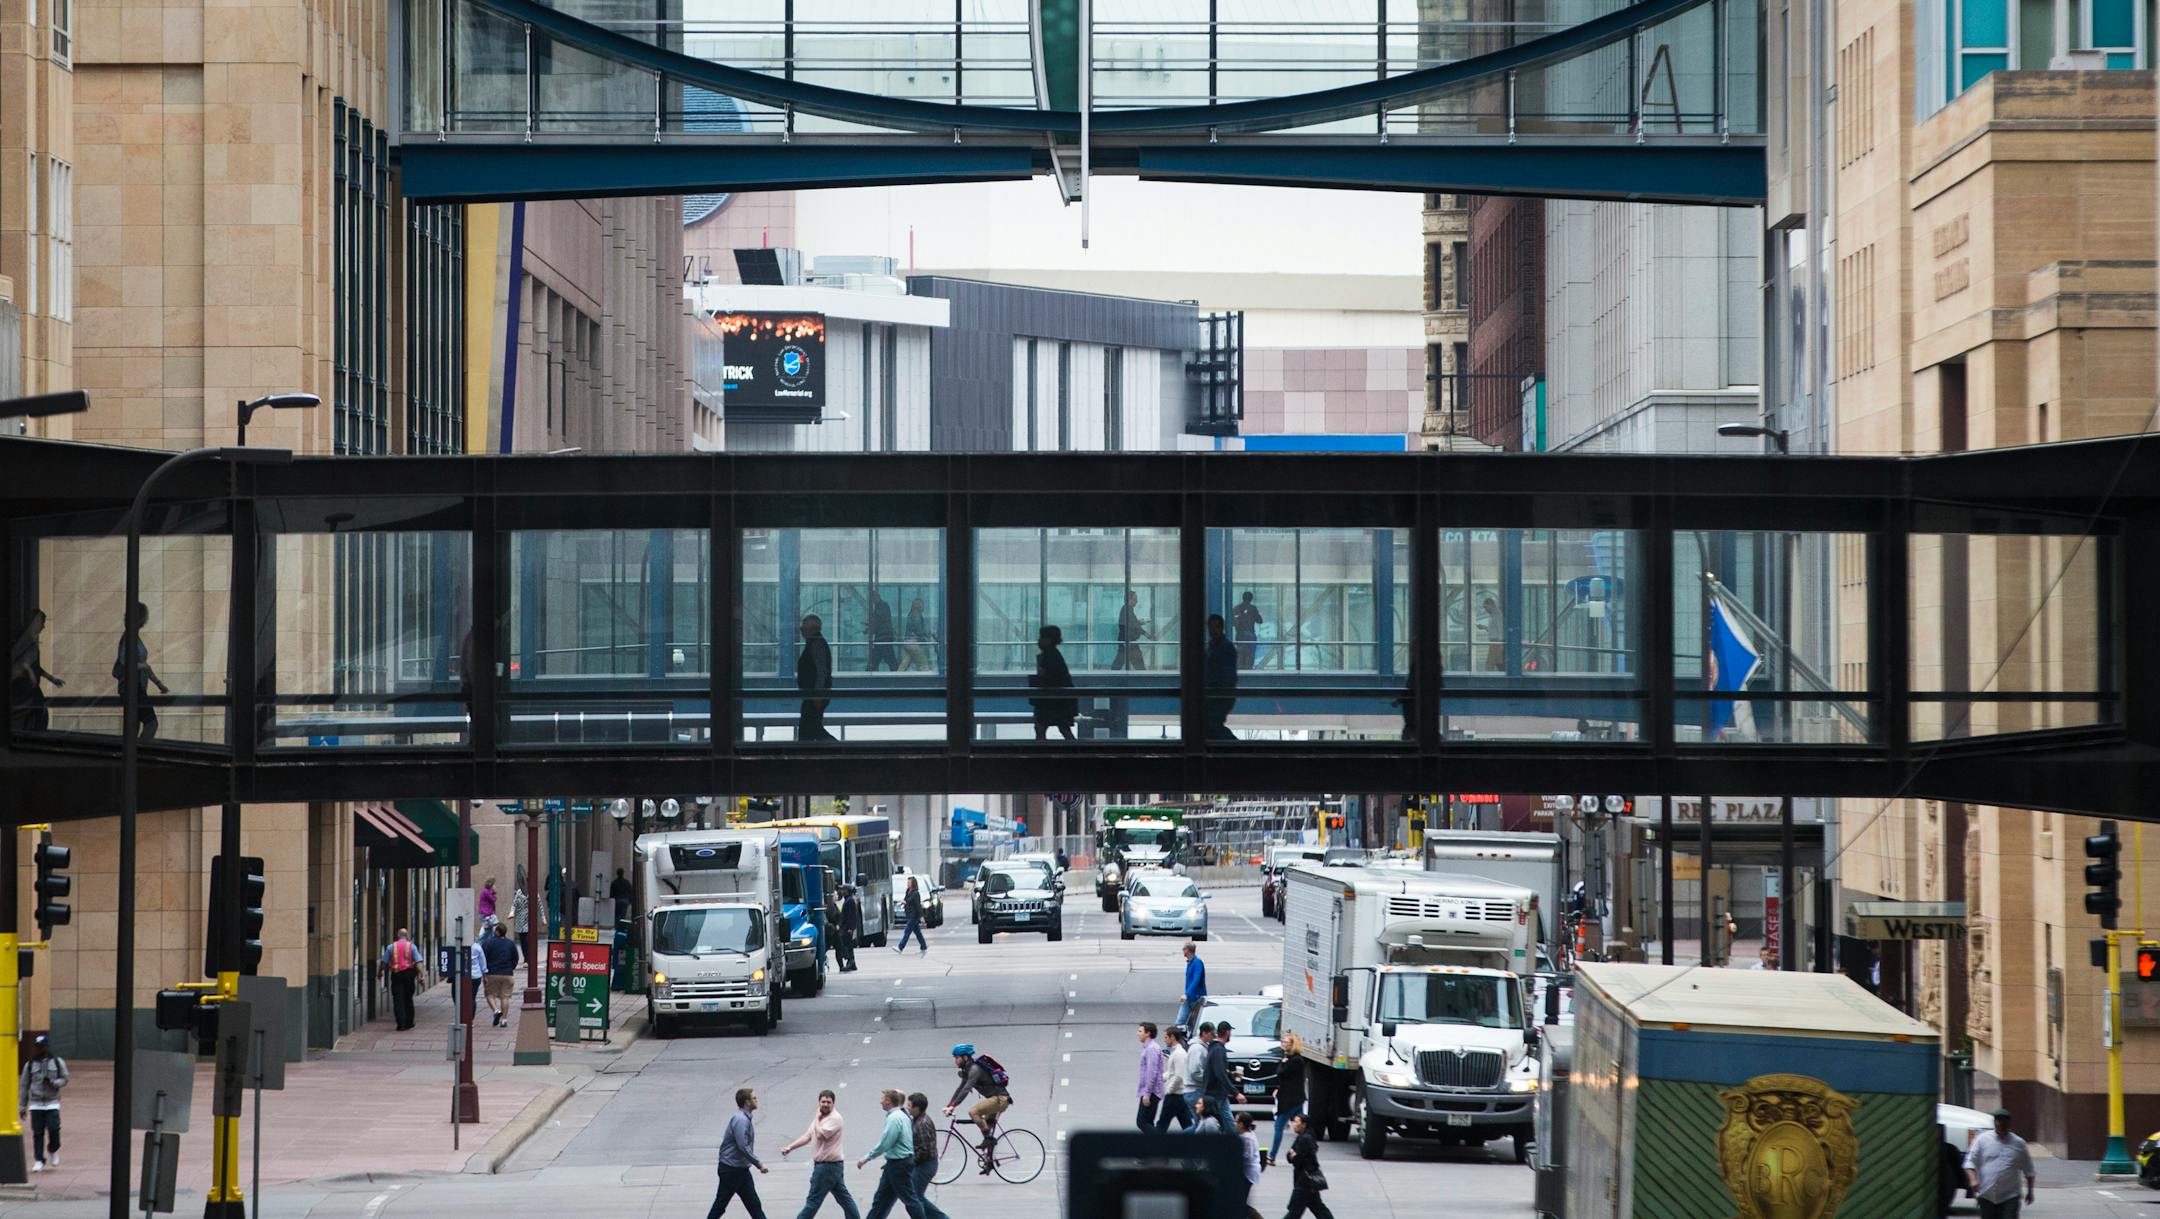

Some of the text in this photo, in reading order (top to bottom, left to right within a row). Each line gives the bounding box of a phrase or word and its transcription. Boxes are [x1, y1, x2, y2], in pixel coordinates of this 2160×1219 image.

[723, 366, 754, 380] TRICK
[440, 951, 448, 972] BUS
[552, 950, 578, 961] Eveng
[552, 961, 606, 972] Weend Special
